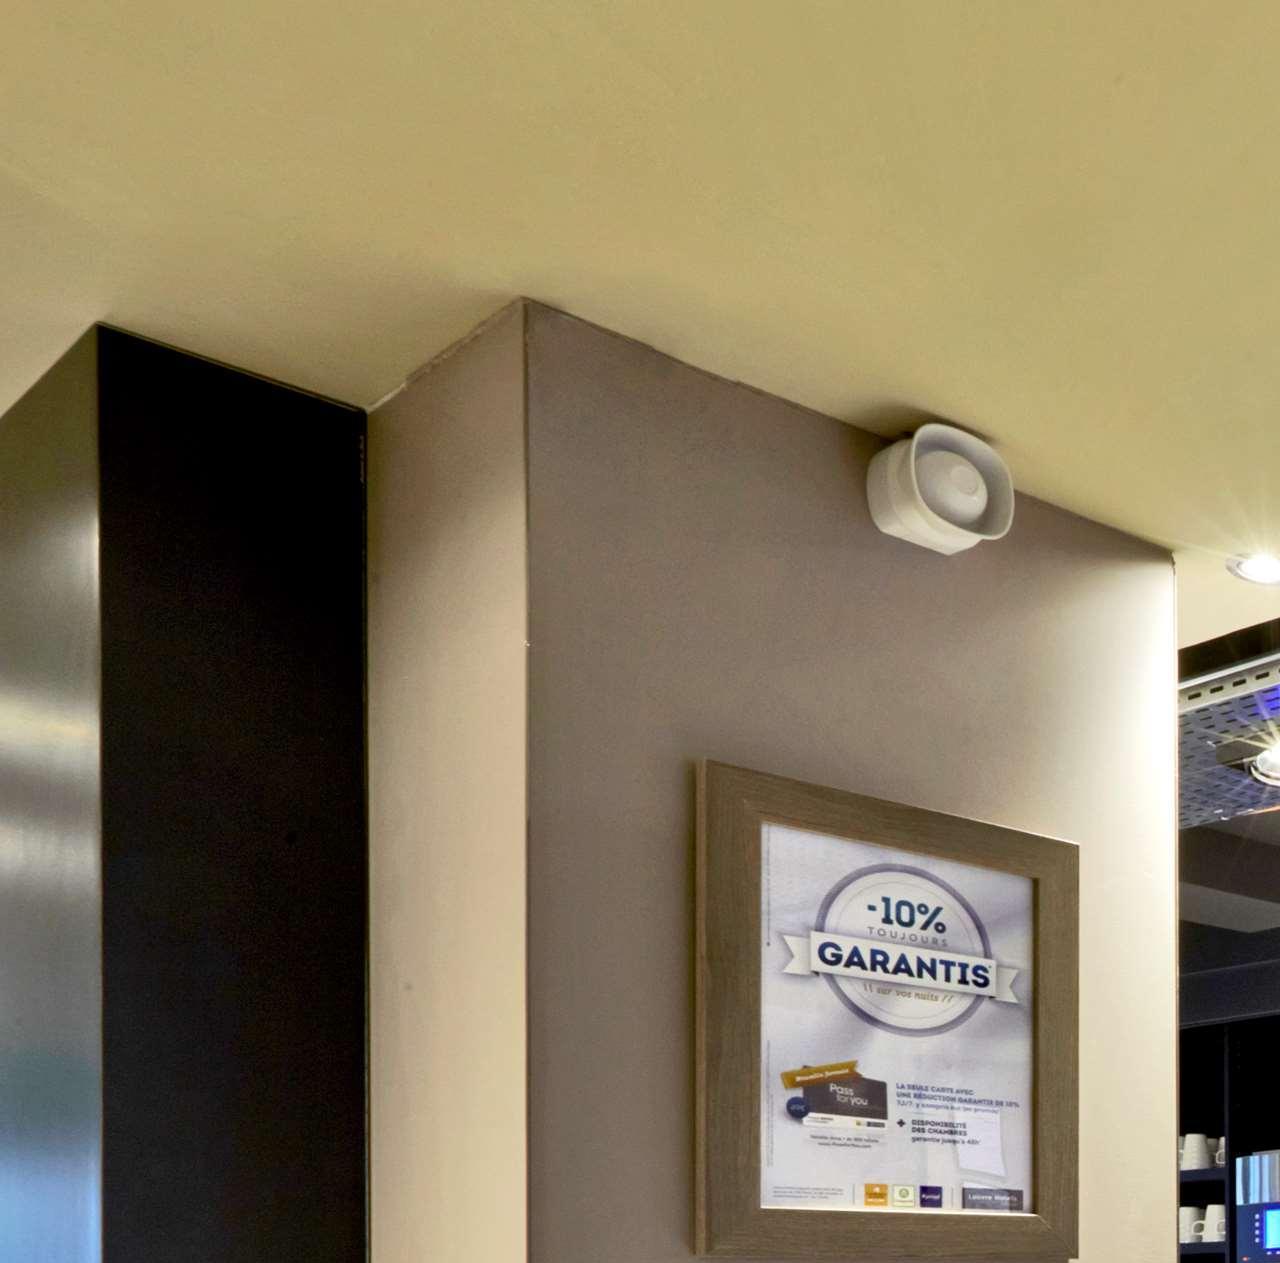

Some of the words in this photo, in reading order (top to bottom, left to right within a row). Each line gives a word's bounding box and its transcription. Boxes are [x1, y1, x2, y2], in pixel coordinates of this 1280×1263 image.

[867, 896, 947, 934] -10%
[867, 926, 949, 947] TOUJOURS
[829, 1083, 855, 1095] Pass
[850, 1096, 868, 1106] you
